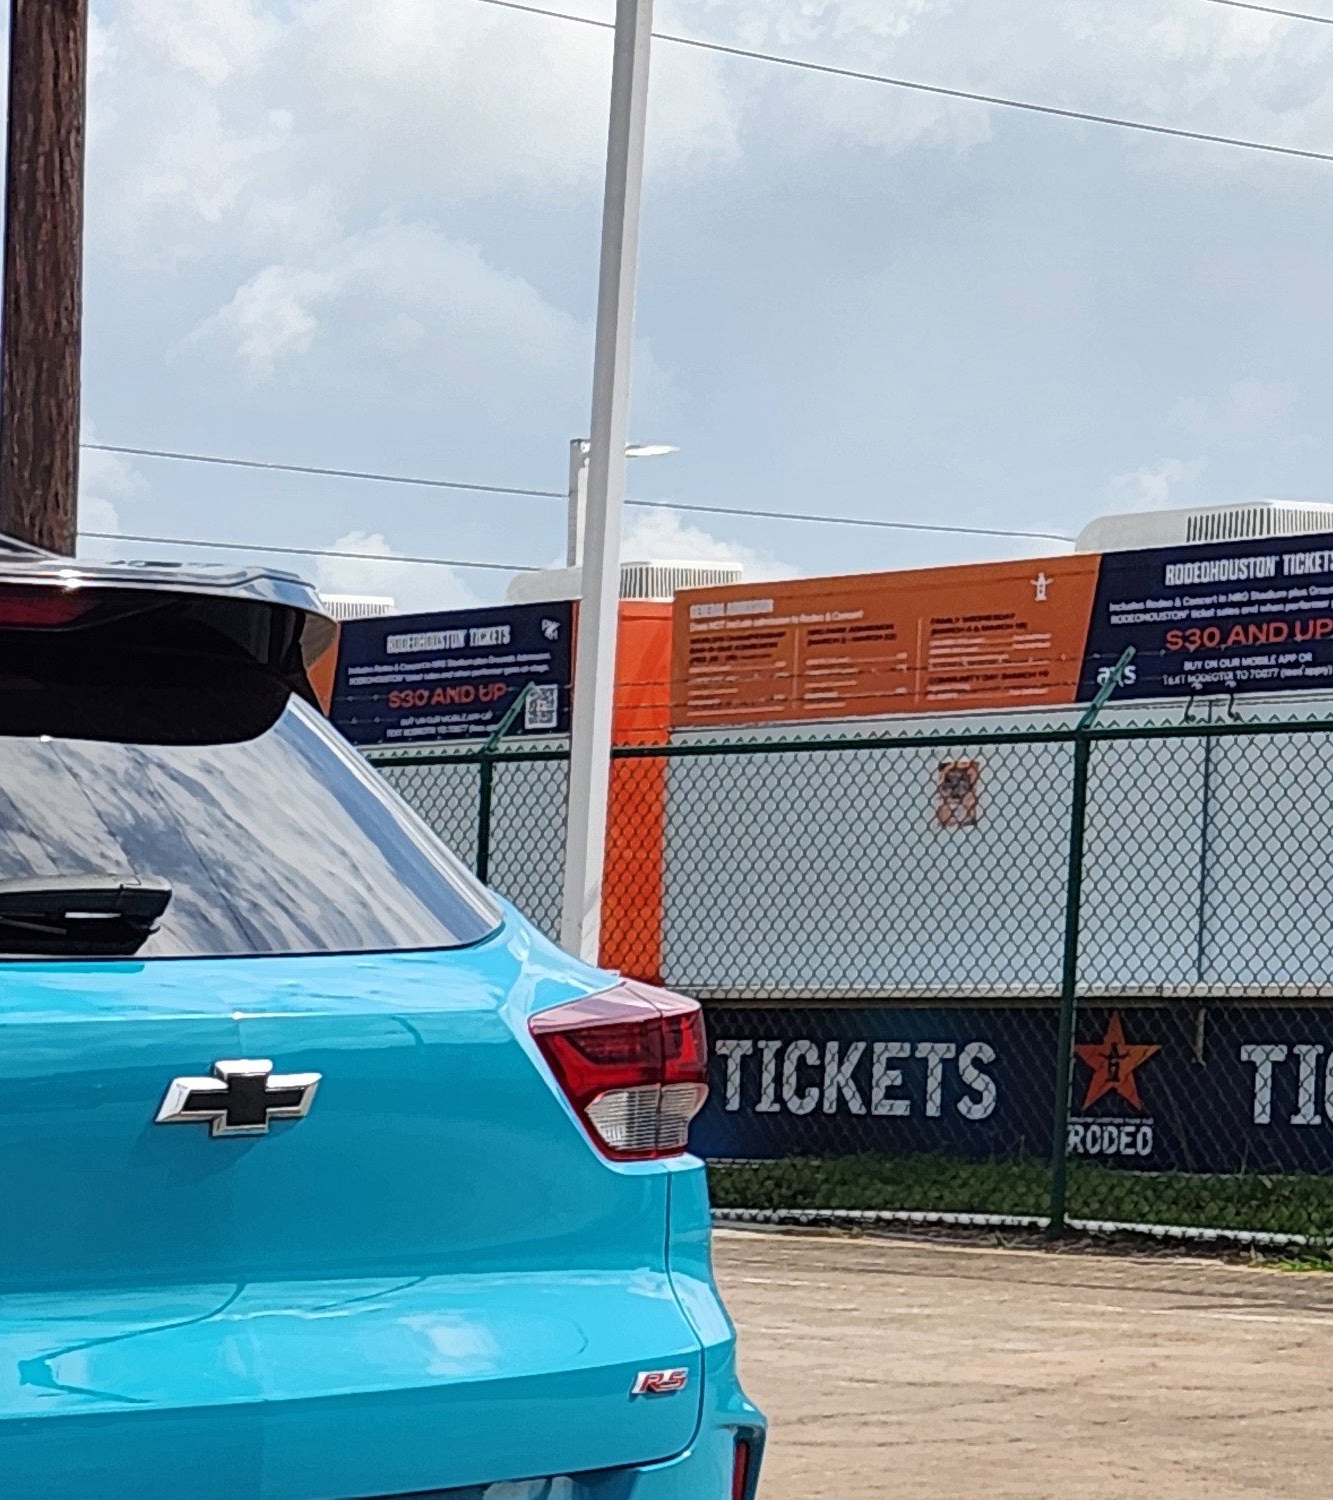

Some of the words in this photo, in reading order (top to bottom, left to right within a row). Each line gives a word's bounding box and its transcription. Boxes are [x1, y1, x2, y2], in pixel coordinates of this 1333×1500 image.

[1226, 621, 1289, 646] AND
[1294, 618, 1333, 642] UP
[431, 685, 475, 705] AND
[478, 682, 507, 703] UP
[715, 1039, 997, 1120] TICKETS
[1066, 1124, 1153, 1156] RODEO
[631, 1366, 689, 1395] RS
